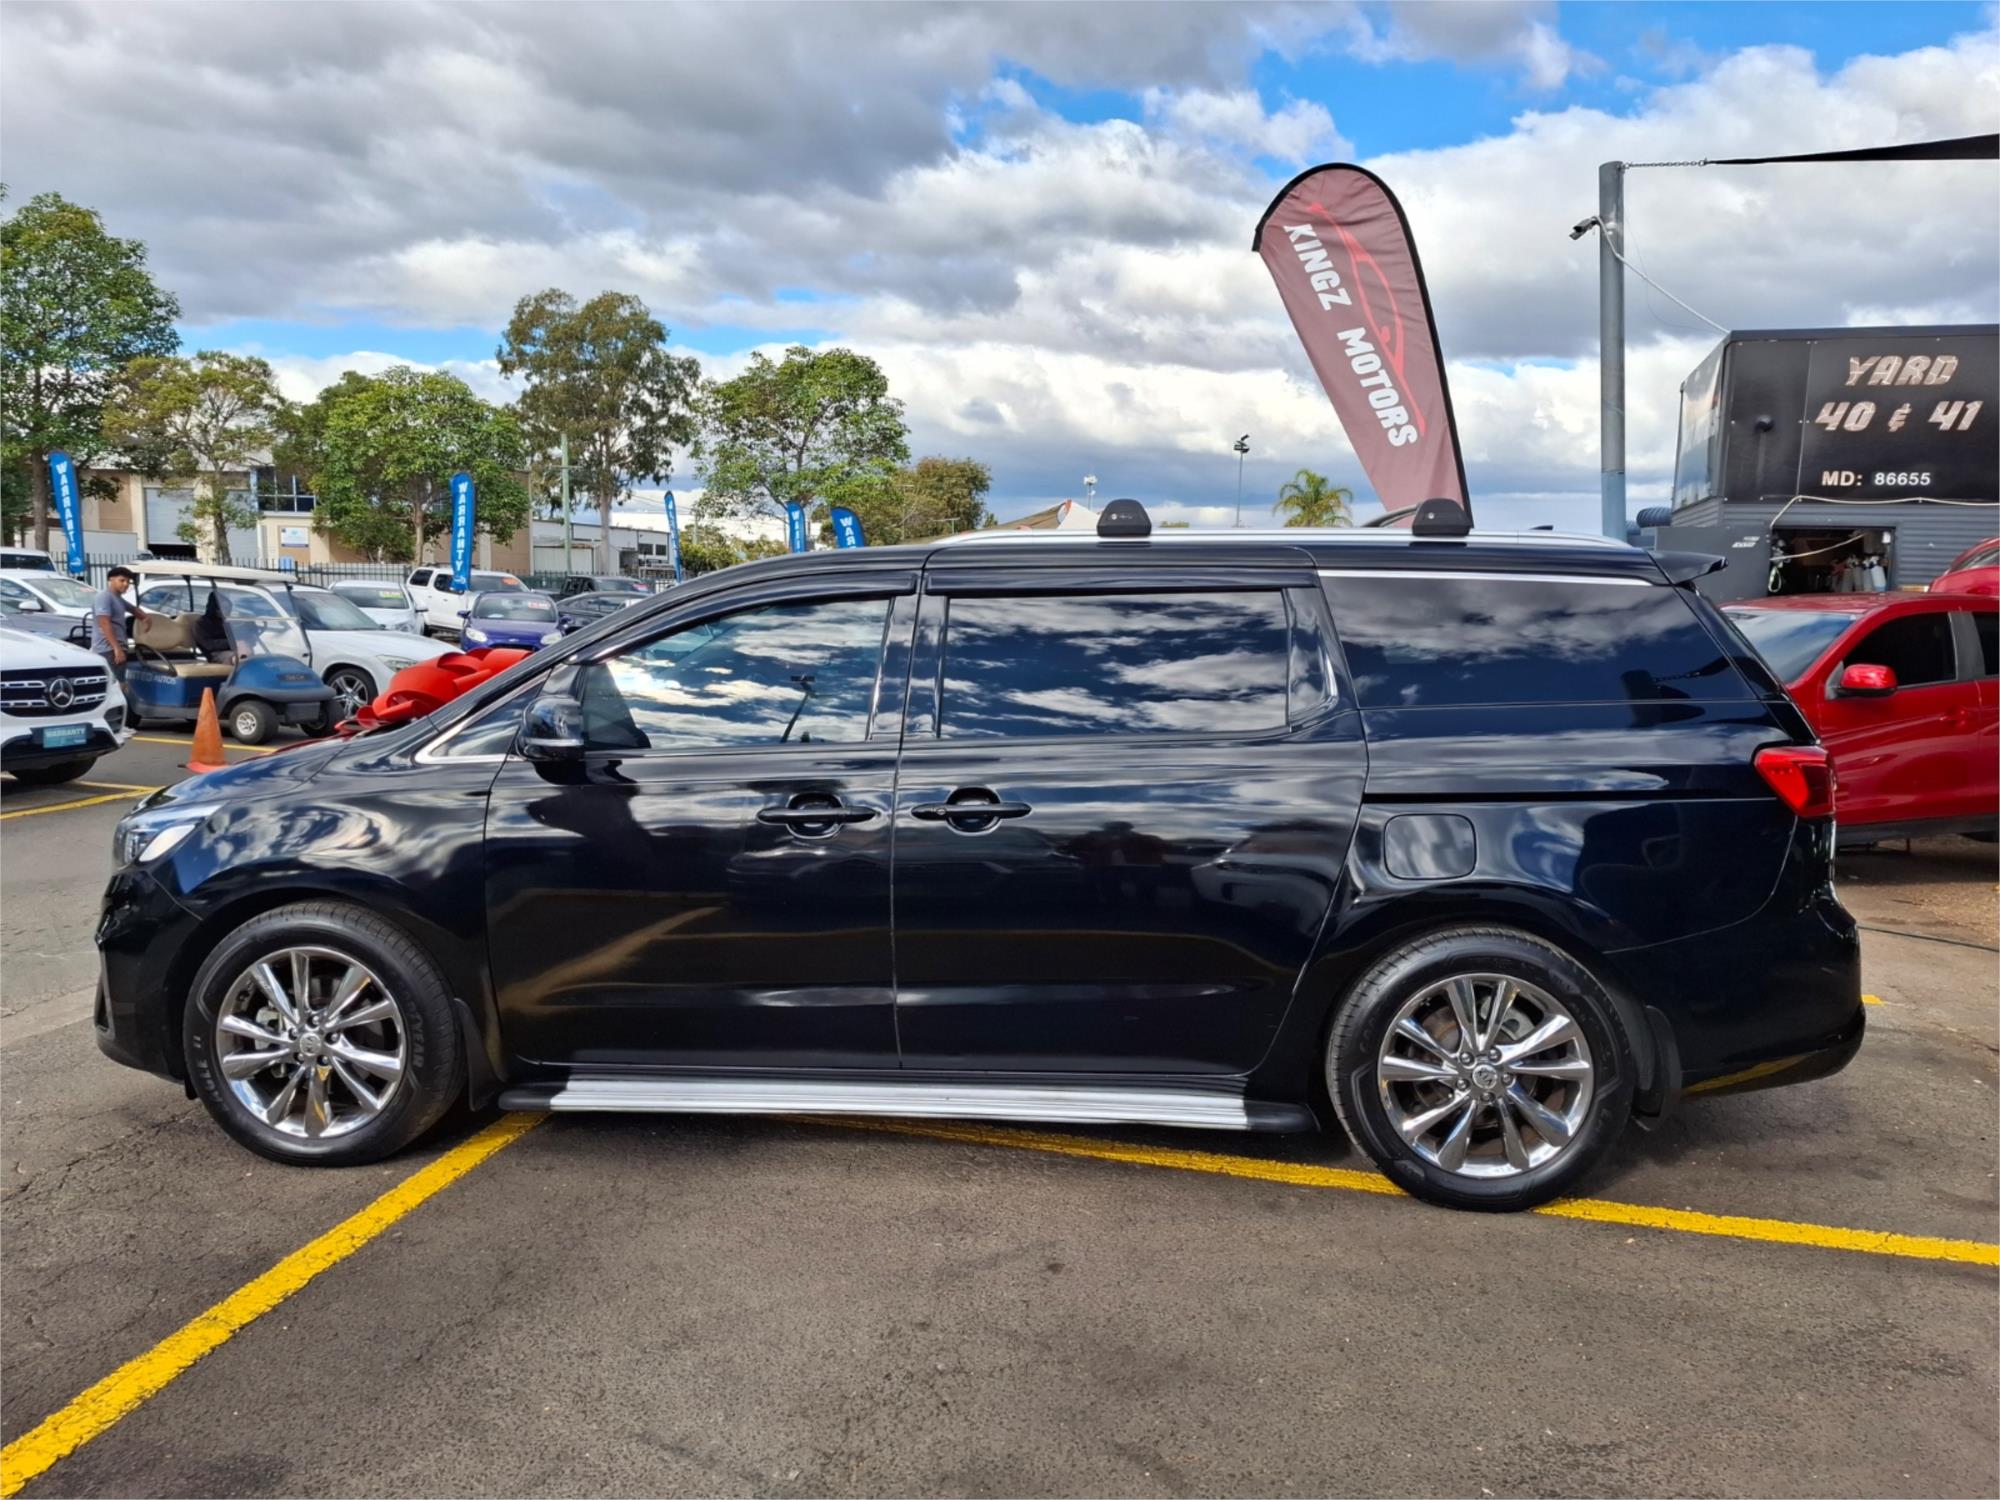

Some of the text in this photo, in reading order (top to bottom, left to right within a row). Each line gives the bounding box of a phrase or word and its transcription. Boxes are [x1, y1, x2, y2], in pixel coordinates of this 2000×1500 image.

[1283, 223, 1418, 447] KINGZ MOTORS
[1845, 355, 1959, 386] YARD
[1814, 400, 1984, 432] 40 & 41
[1821, 471, 1932, 487] MD: 86655
[455, 482, 468, 572] WARRANTY
[840, 516, 857, 549] WAR
